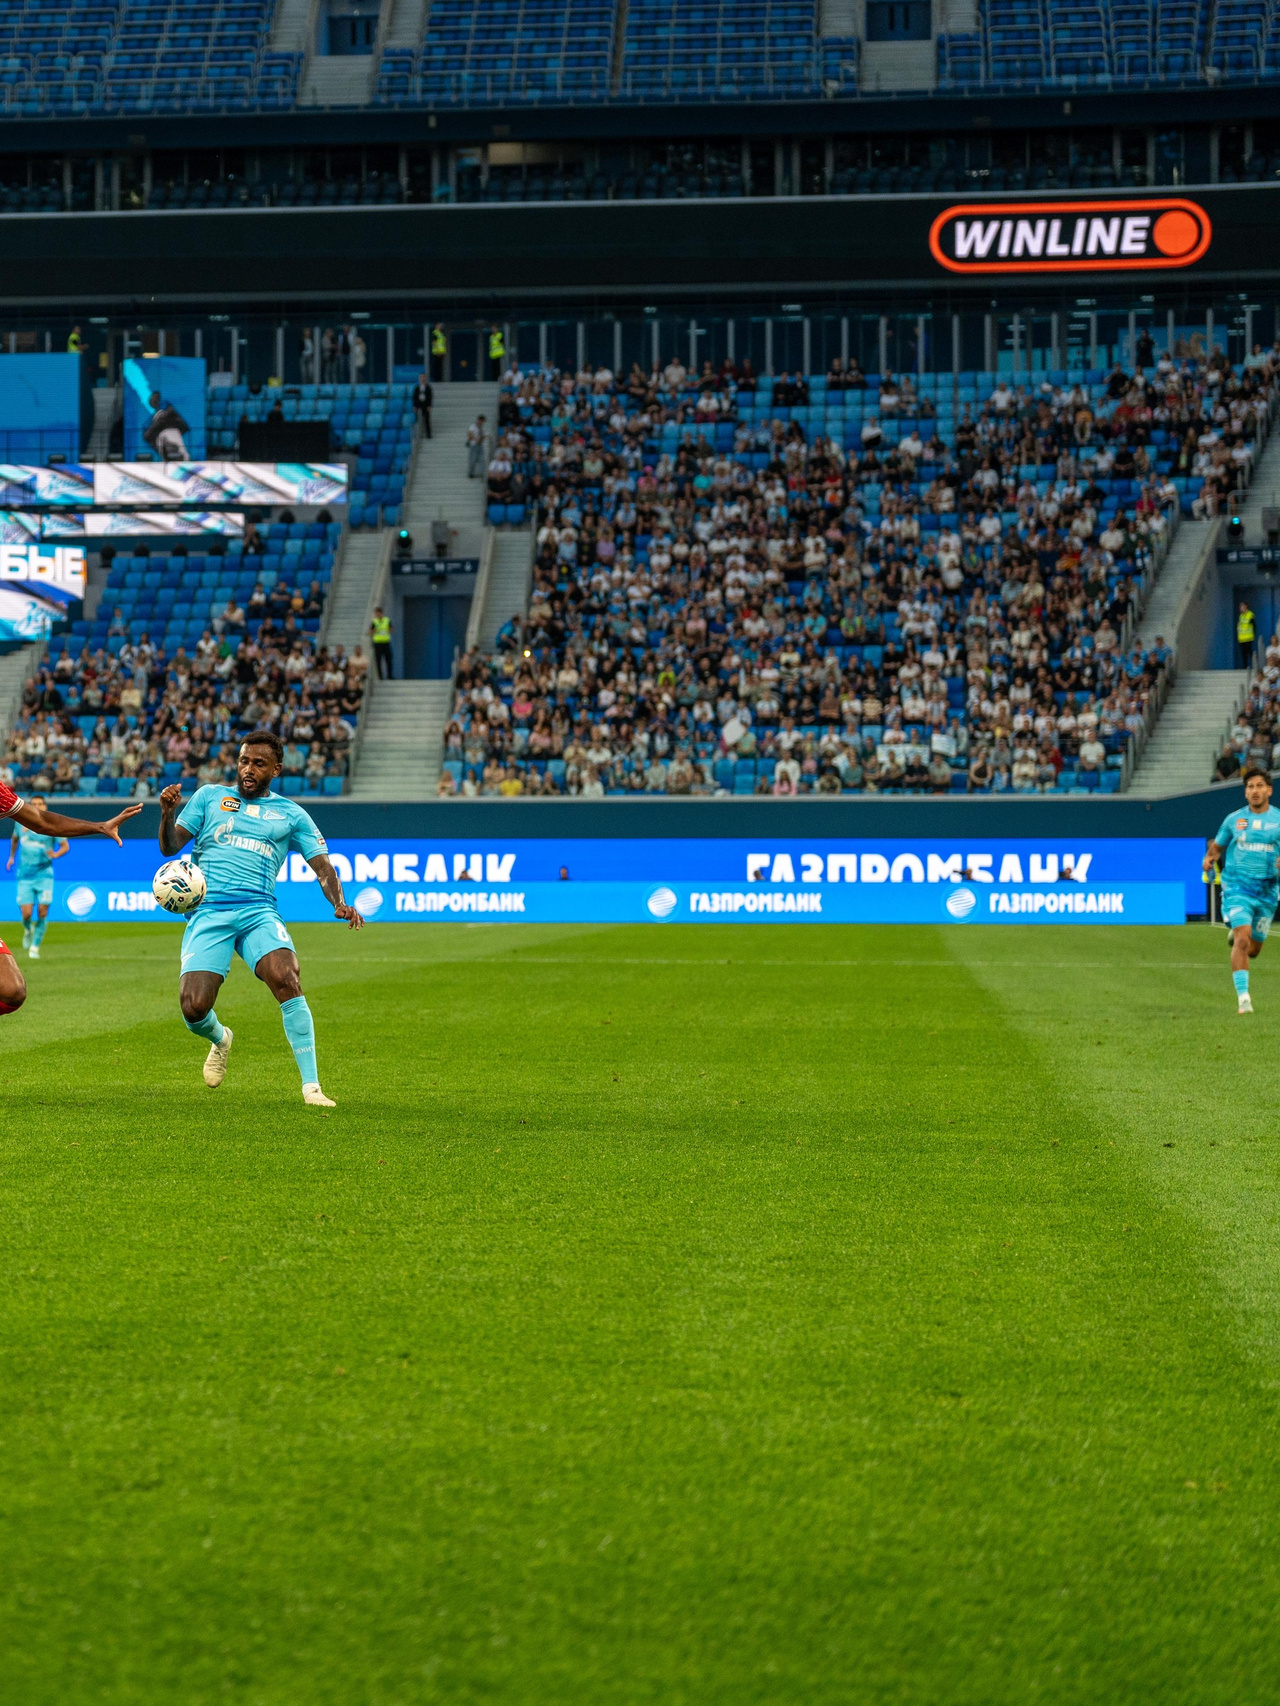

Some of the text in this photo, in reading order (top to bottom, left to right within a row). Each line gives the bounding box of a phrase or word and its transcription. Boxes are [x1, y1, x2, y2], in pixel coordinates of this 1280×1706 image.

[955, 216, 1150, 258] WINLINE
[230, 835, 274, 858] ГАЗПРОМ
[395, 892, 526, 912] ГАЗПРОМБАНК
[690, 892, 823, 912] ГАЗПРОМБАНК
[989, 892, 1124, 913] ГАЗПРОМБАНК
[275, 921, 290, 942] 8
